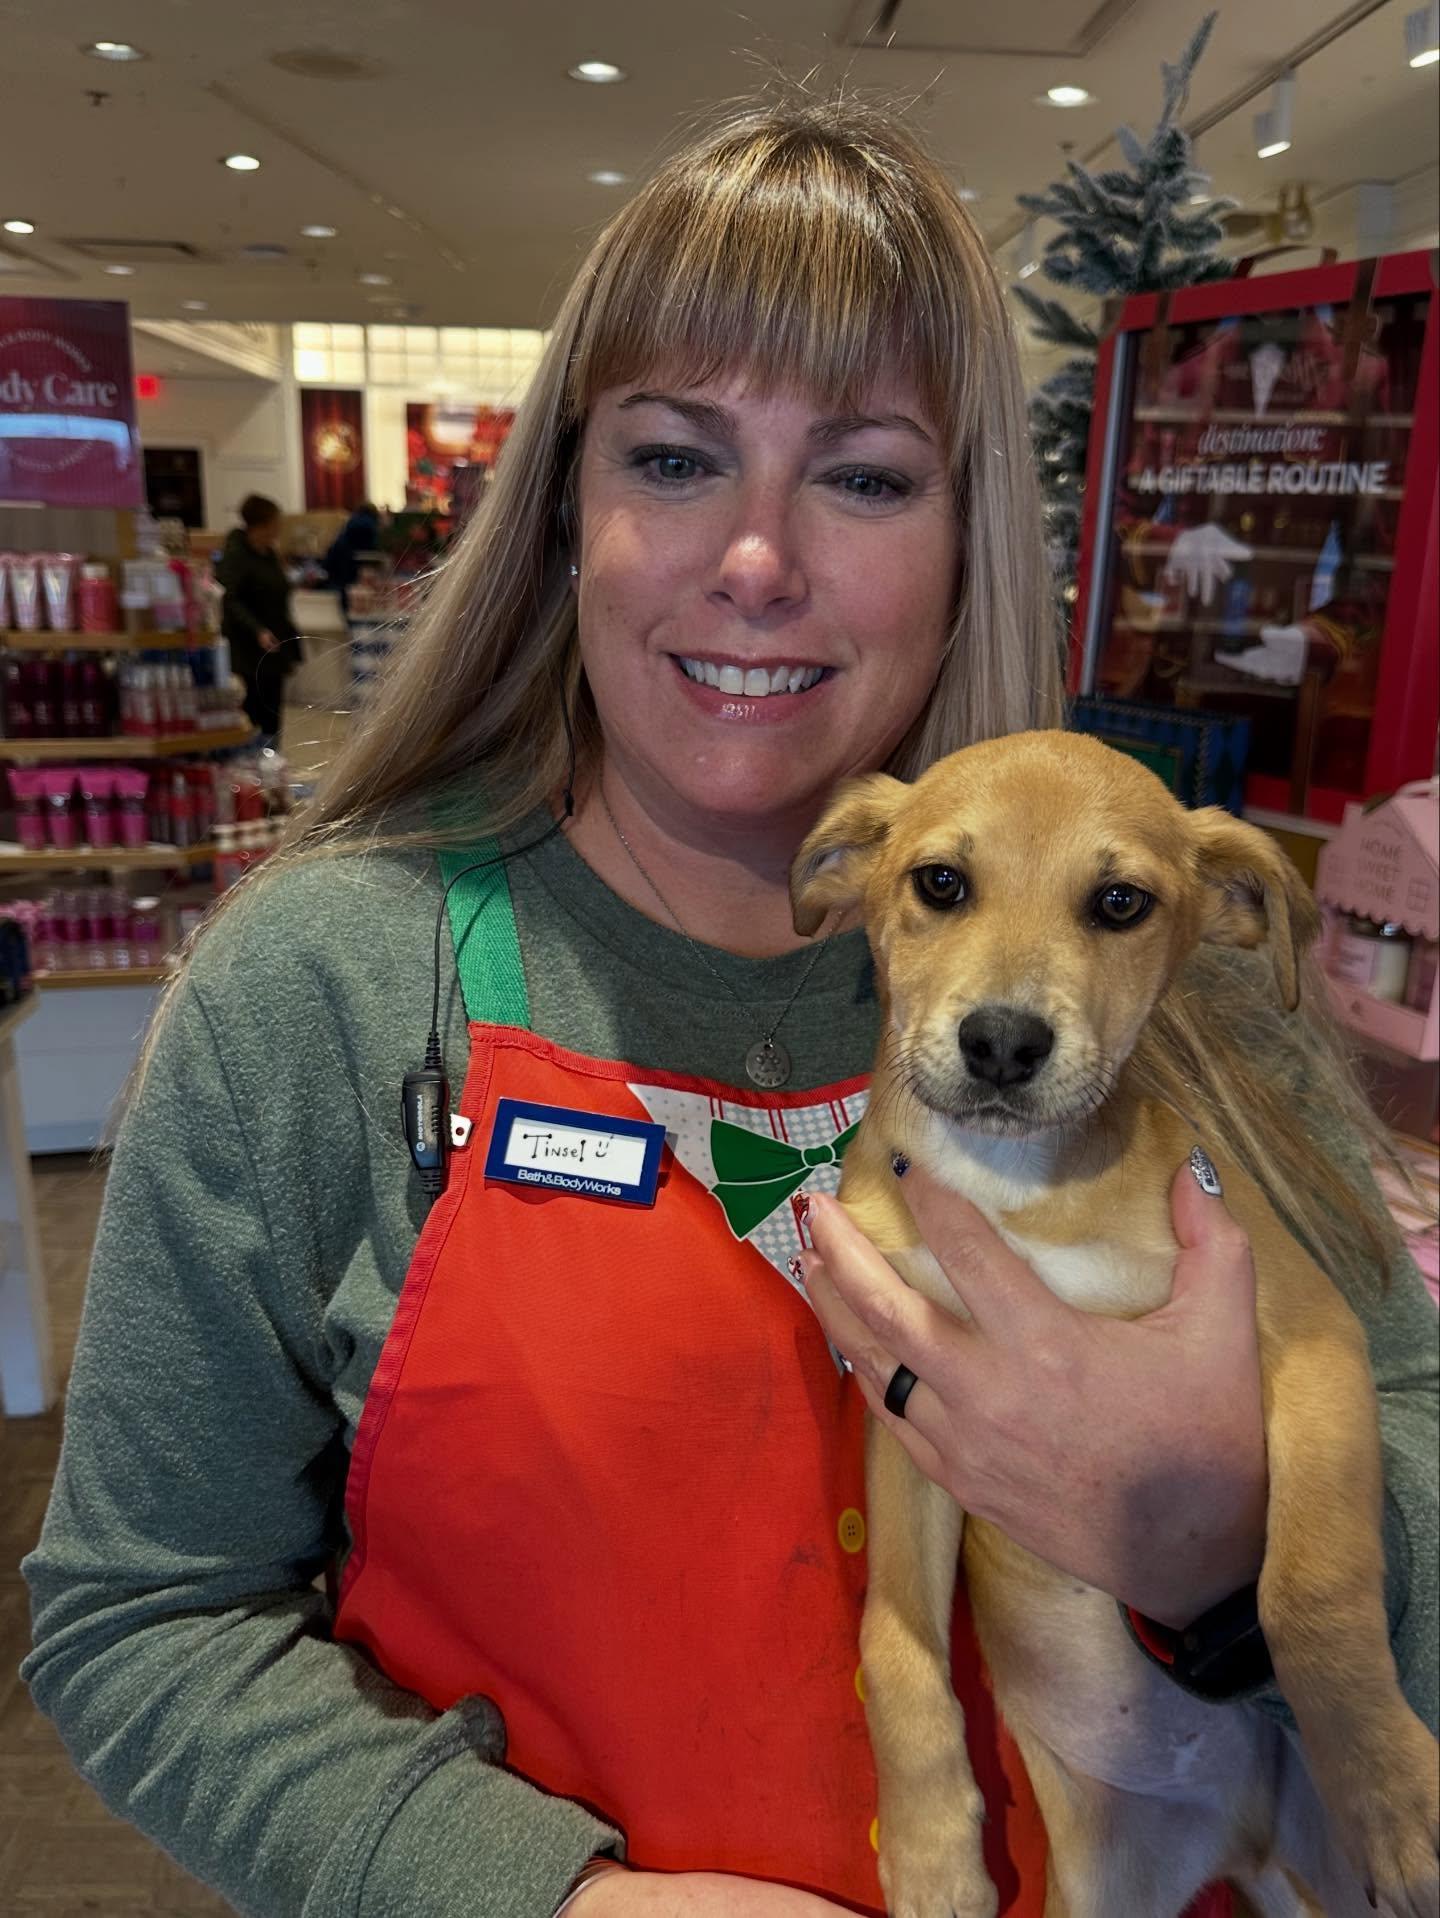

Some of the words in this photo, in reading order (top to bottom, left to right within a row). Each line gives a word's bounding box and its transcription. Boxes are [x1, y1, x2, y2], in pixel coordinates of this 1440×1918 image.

[42, 372, 119, 408] Care
[1138, 466, 1157, 494] A
[1157, 463, 1265, 494] GIFTABLE
[1267, 460, 1391, 494] ROUTINE
[1361, 838, 1402, 862] HOME
[416, 1094, 424, 1140] MOTOROLA
